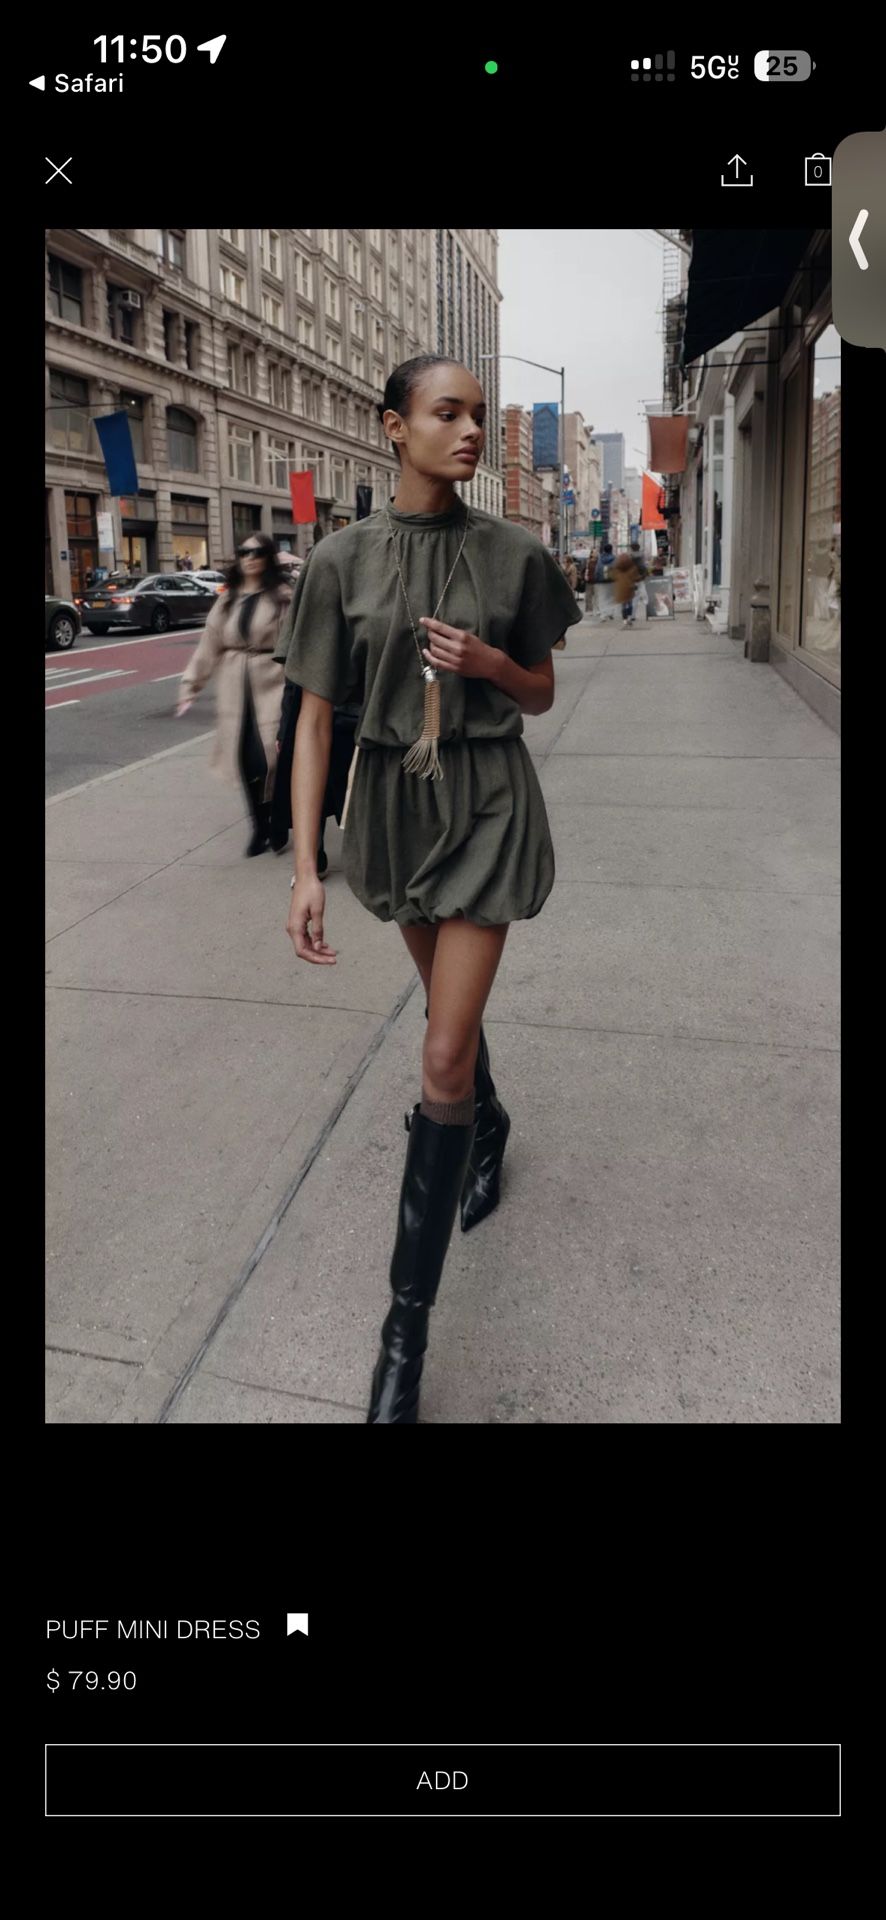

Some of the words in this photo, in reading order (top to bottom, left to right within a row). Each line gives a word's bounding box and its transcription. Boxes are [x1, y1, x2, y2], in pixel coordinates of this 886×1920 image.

[93, 34, 187, 64] 11:50
[765, 55, 798, 77] 25
[54, 73, 124, 93] Safari
[813, 165, 823, 179] 0
[46, 1619, 109, 1640] PUFF
[117, 1619, 167, 1640] MINI
[177, 1619, 260, 1640] DRESS
[46, 1667, 60, 1694] $
[68, 1670, 137, 1691] 79.90
[415, 1770, 469, 1790] ADD
